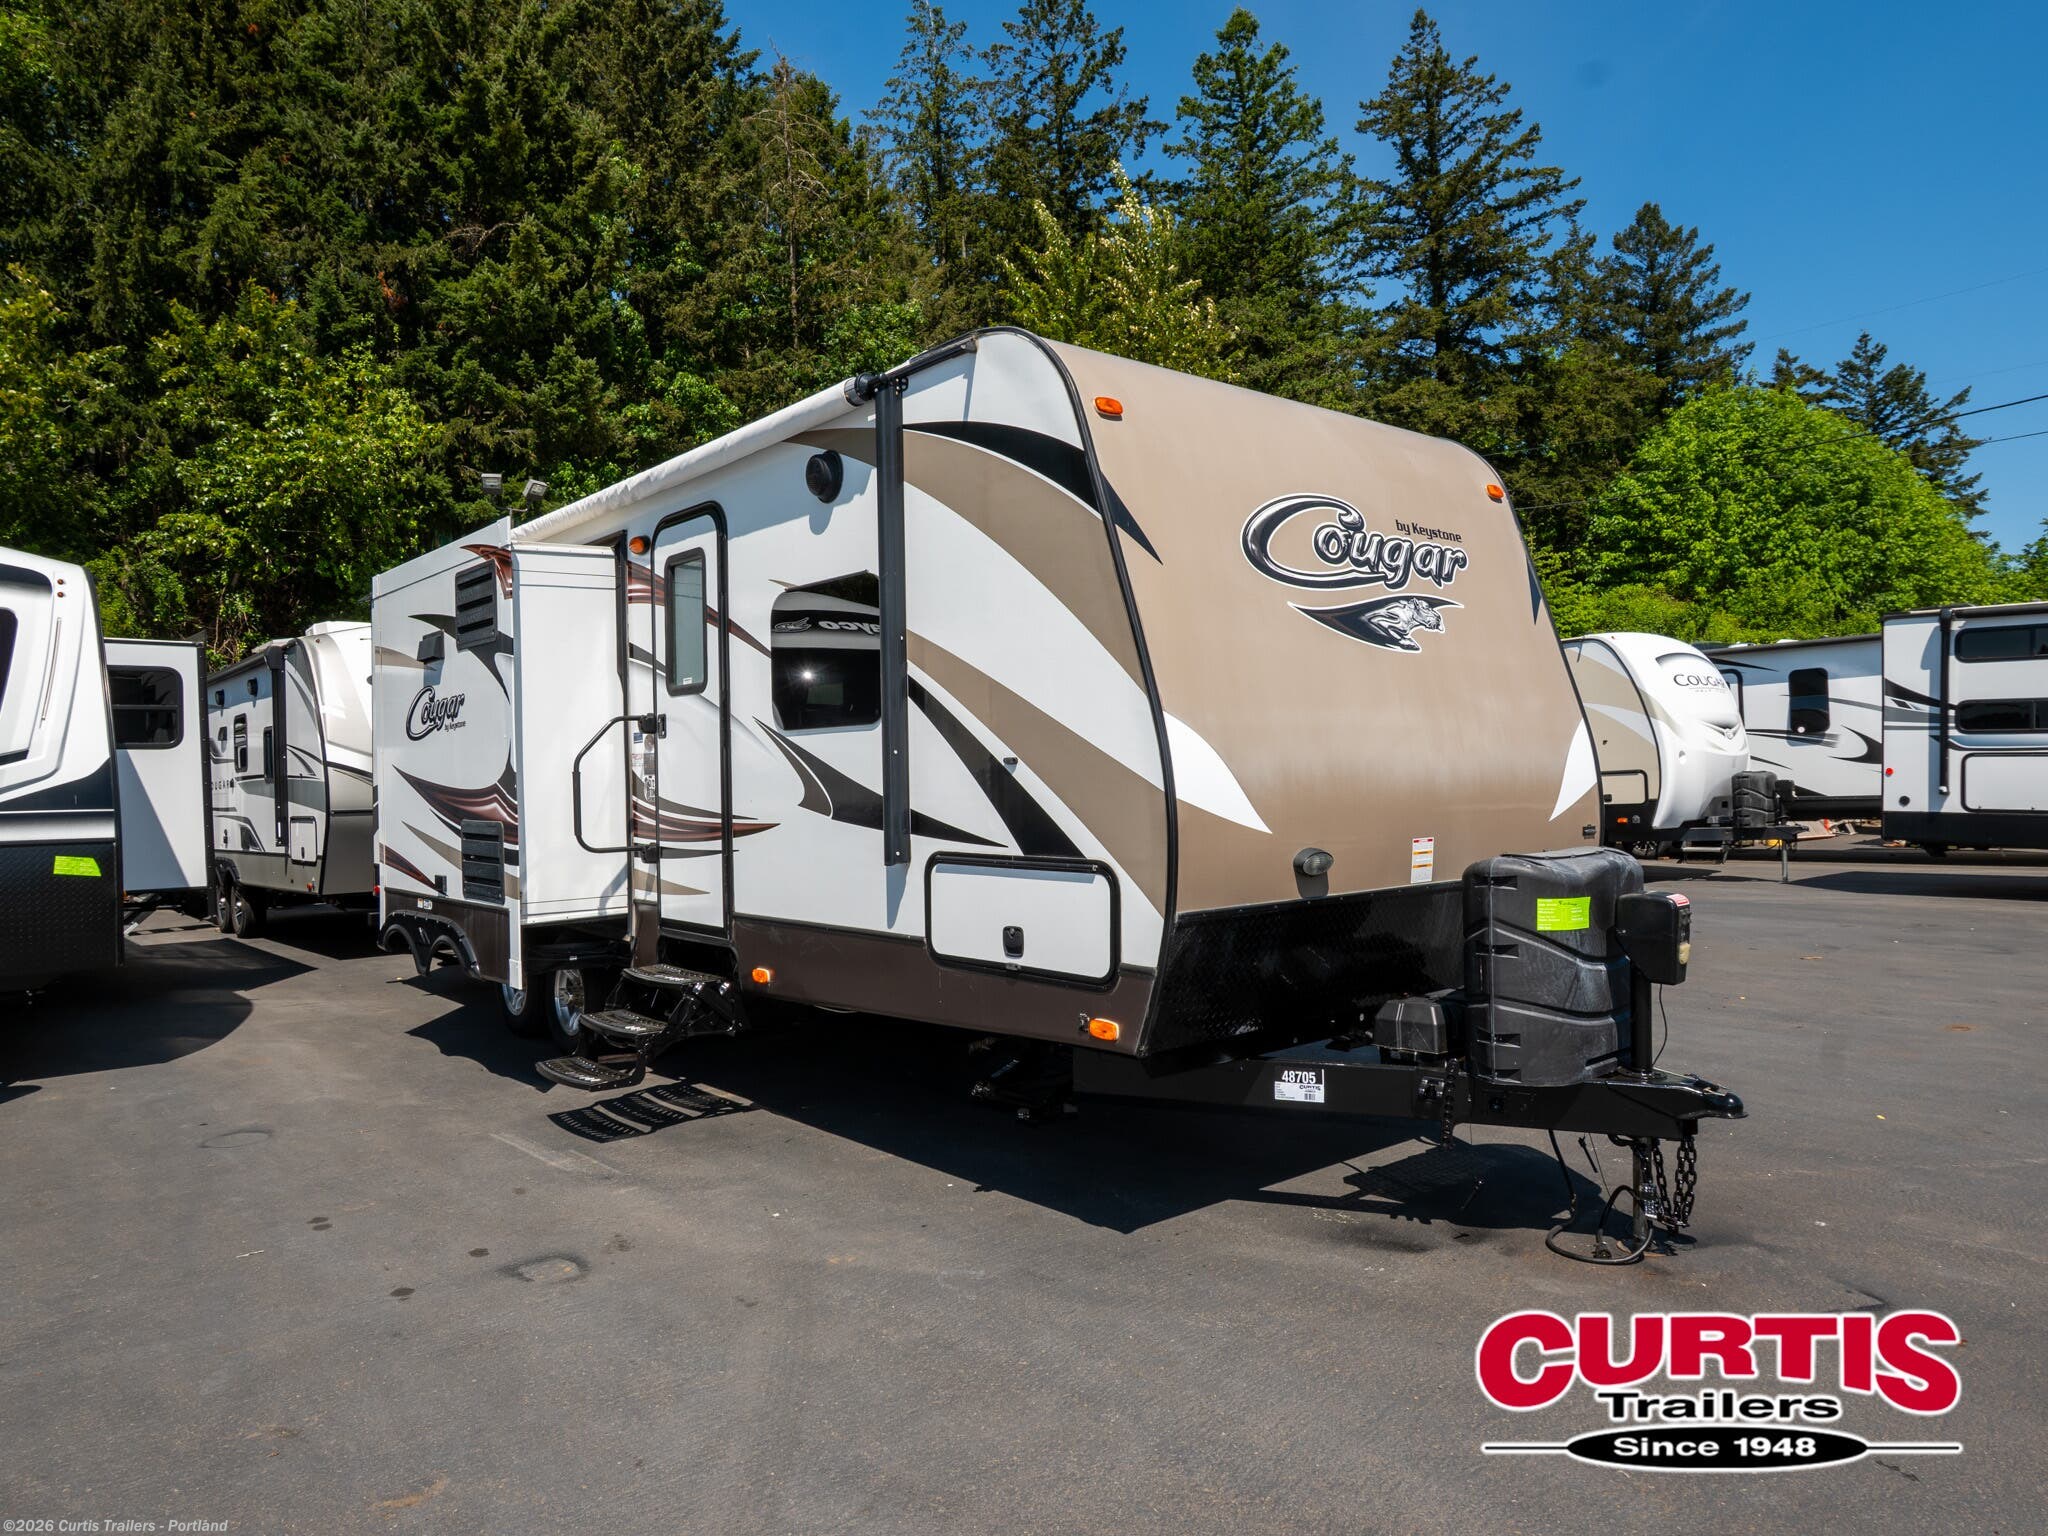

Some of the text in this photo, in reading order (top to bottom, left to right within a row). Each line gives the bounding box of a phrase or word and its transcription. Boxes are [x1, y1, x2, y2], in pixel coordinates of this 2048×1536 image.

[1241, 493, 1468, 590] Cougar
[1395, 519, 1462, 543] by Keystone
[406, 685, 466, 741] Cougar
[1281, 1070, 1317, 1084] 48705
